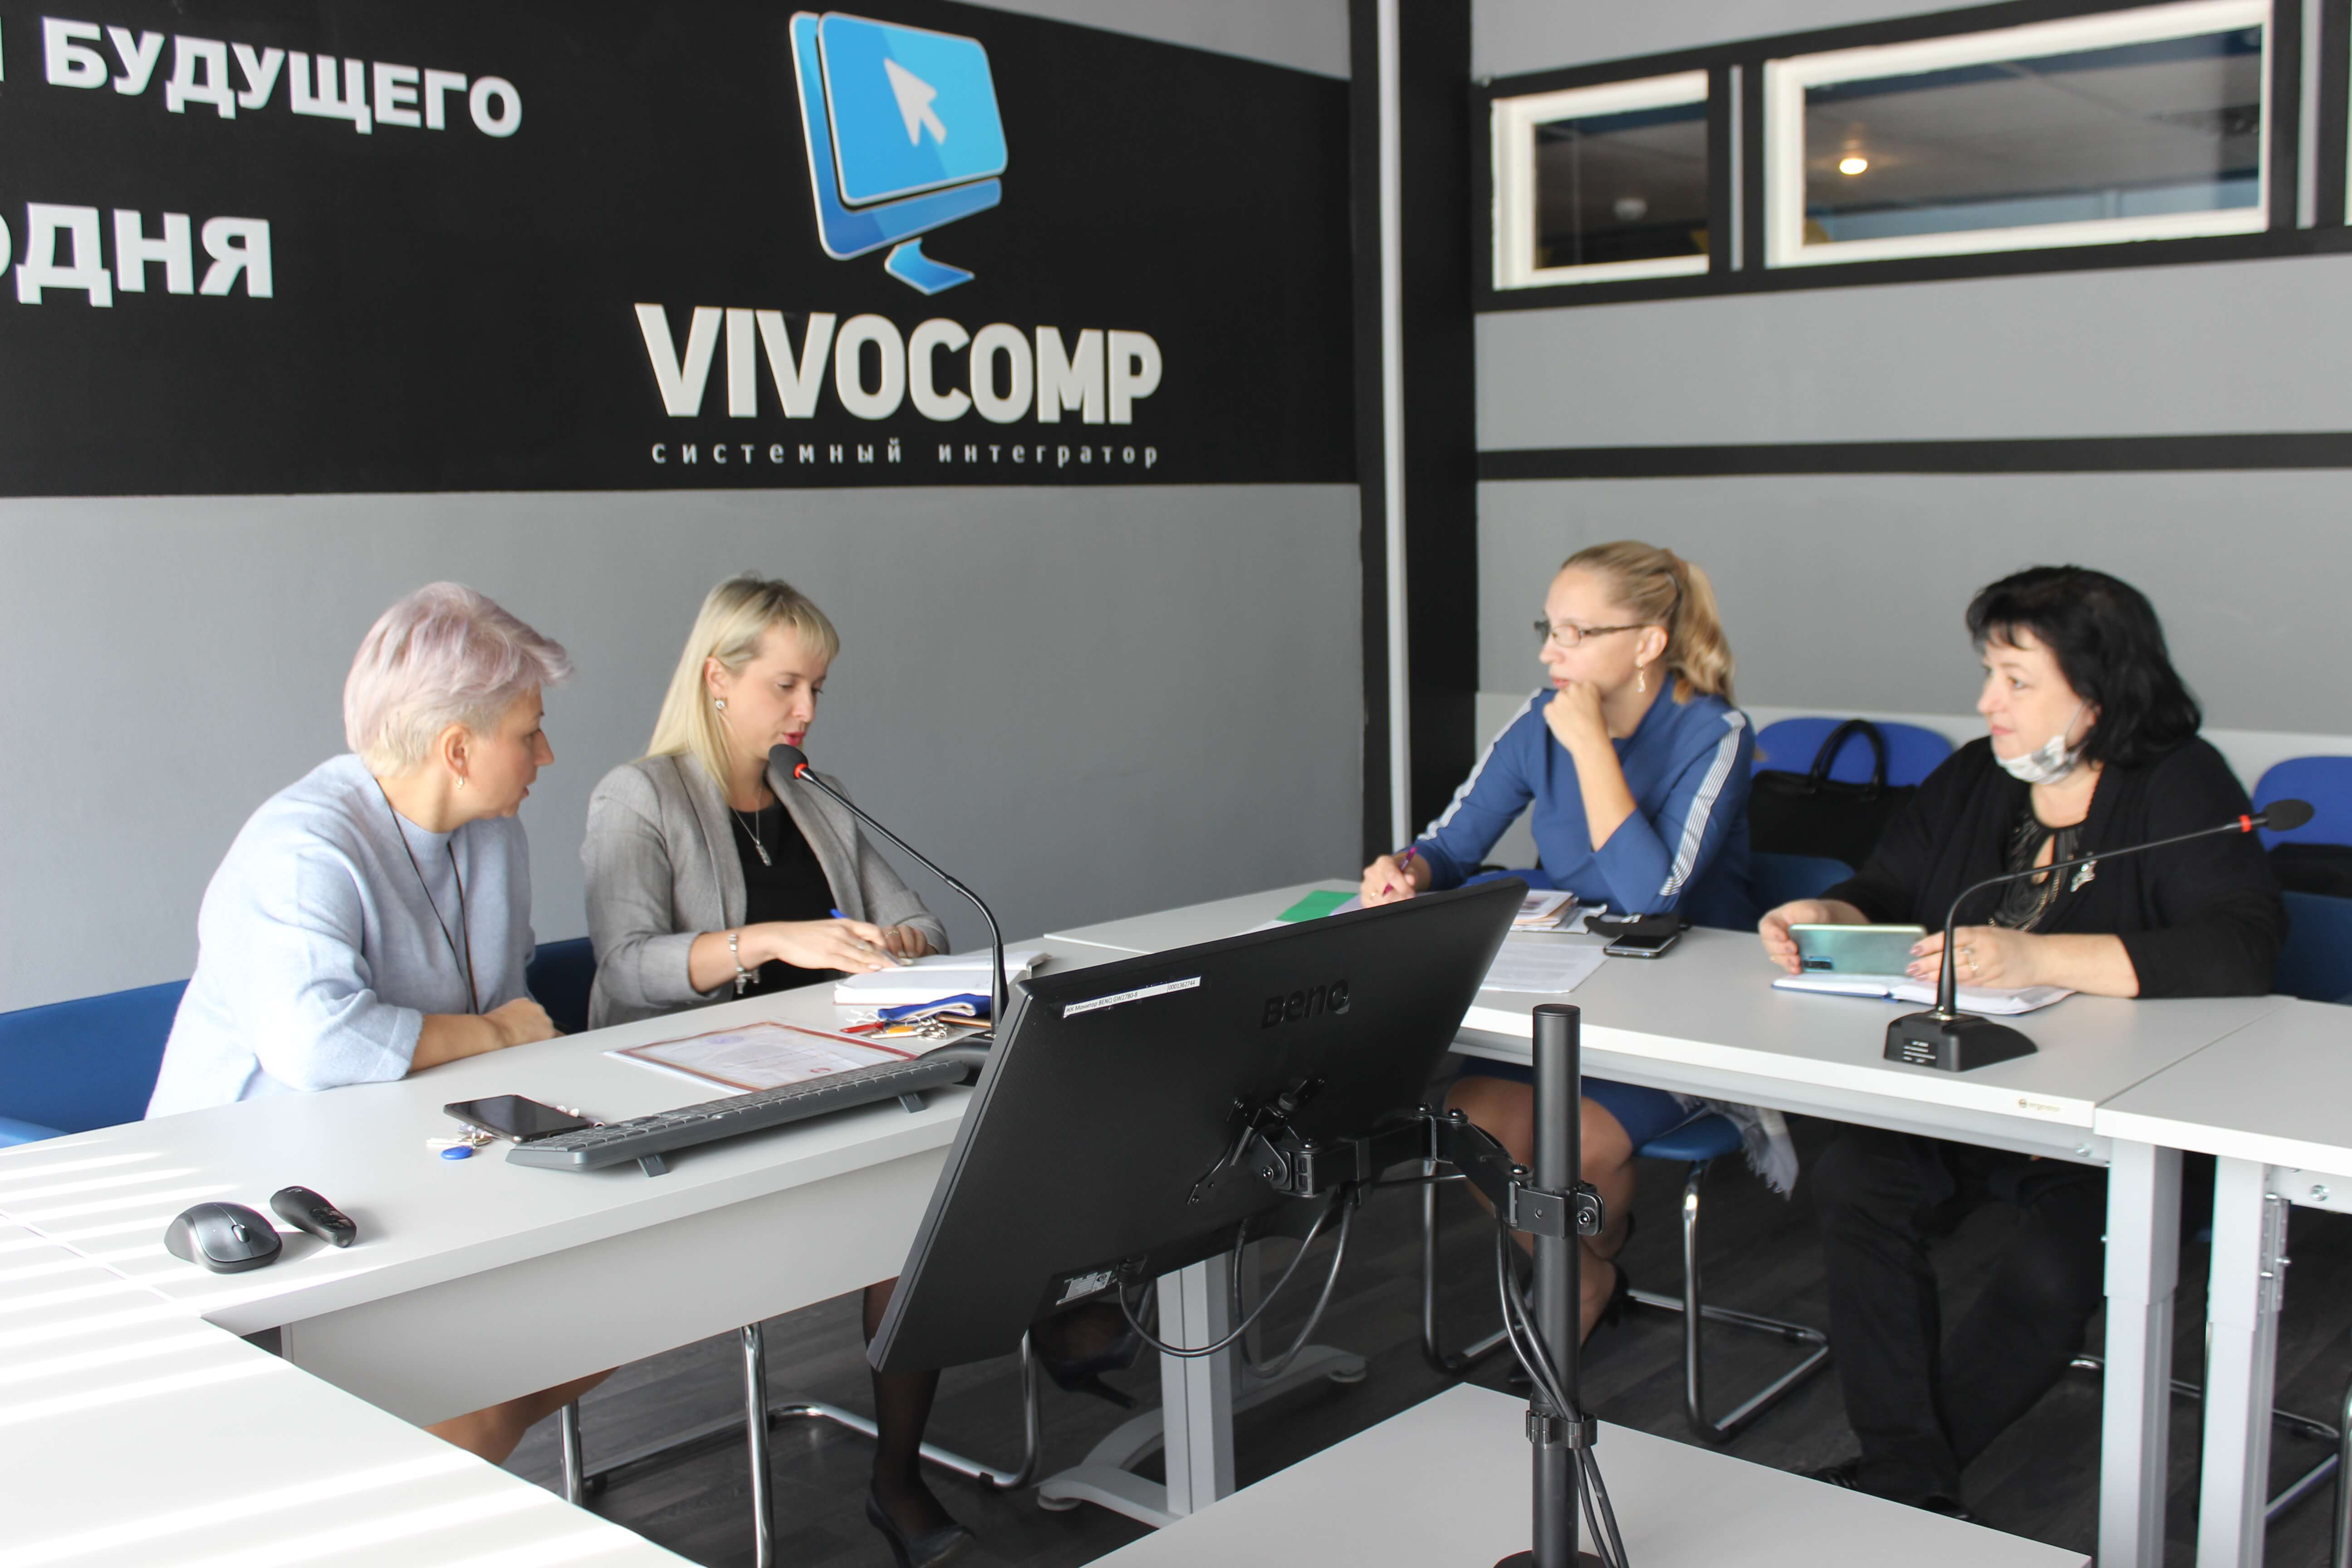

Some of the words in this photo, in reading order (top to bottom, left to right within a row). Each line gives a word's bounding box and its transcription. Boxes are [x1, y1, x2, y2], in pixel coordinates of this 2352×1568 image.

[42, 16, 522, 137] БУДУЩЕГО
[0, 202, 274, 308] ДНЯ
[634, 303, 1162, 424] VIVOCOMP
[652, 438, 902, 465] системный
[938, 444, 1159, 469] интегратор
[1075, 1001, 1098, 1011] Монитор
